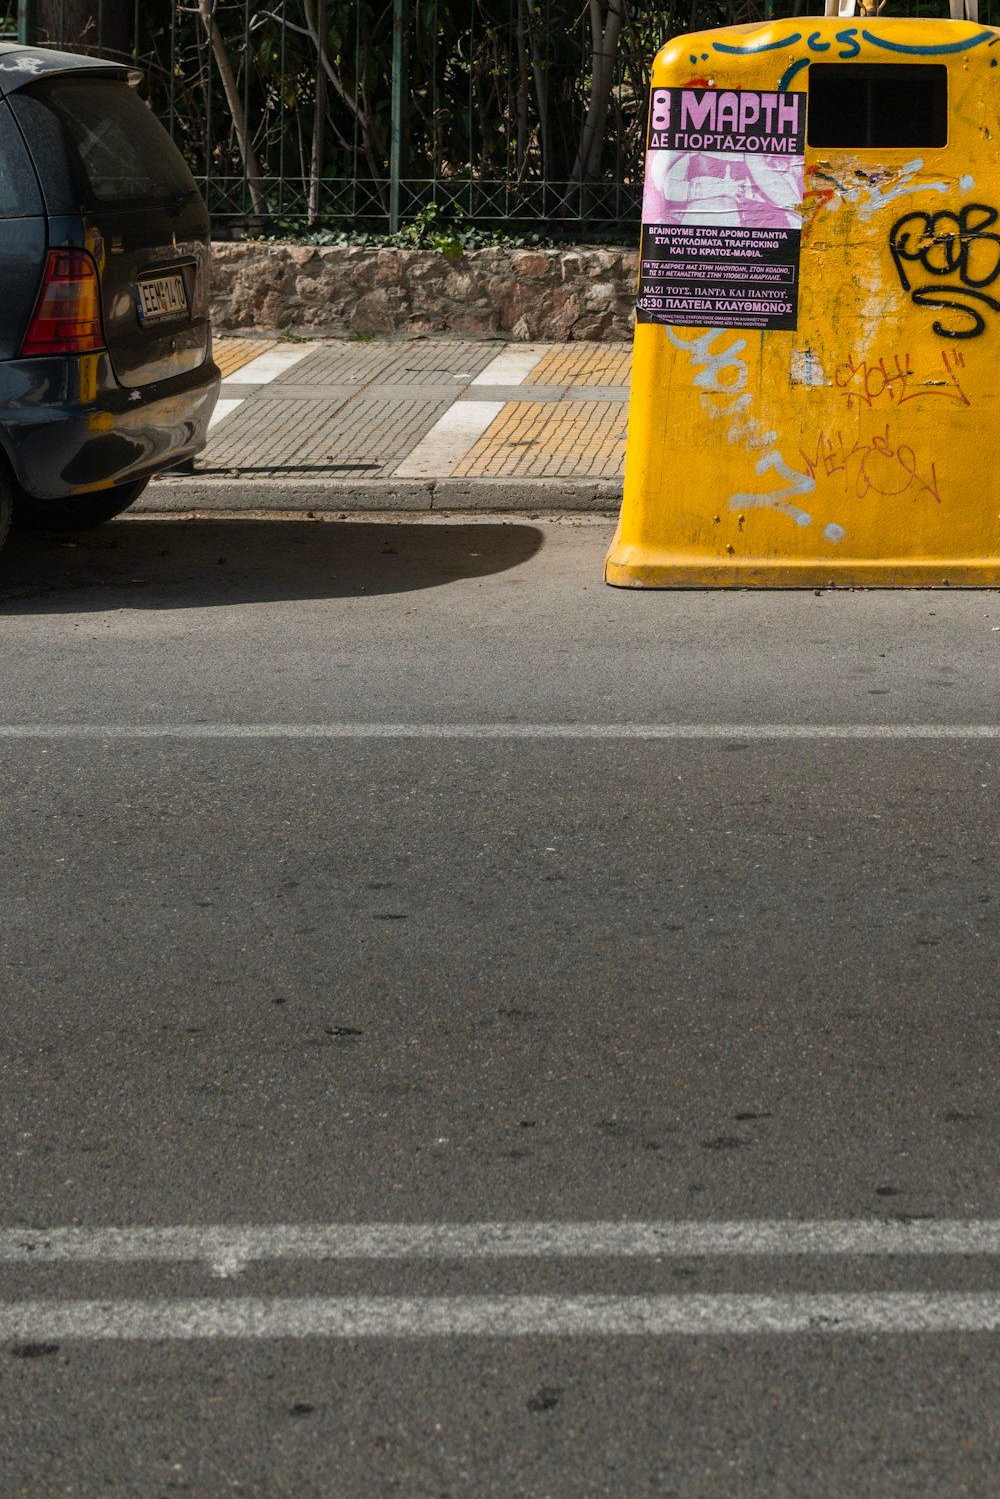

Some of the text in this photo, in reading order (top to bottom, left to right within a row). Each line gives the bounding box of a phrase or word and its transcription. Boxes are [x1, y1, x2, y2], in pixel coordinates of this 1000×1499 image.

[653, 89, 799, 134] 8 ΜΑΡΤΗ
[651, 133, 796, 152] ΔΕ ΓΙΟΡΤΑΖΟΥΜΕ
[649, 227, 788, 240] ΒΓΑΙΝΟΥΜΕ ΣΤΟΝ ΔΡΟΜΟ ΕΝΑΝΤΙΑ
[655, 237, 779, 249] ΣΤΑ ΚΥΚΛΩΜΑΤΑ TRAFFICKING
[670, 247, 685, 255] ΚΑΙ
[700, 248, 763, 258] ΚΡΑΤΟΣ-ΜΑΦΙΑ.
[643, 286, 663, 294] ΜΑΖΙ
[666, 287, 692, 295] ΤΟΥΣ.
[694, 288, 726, 296] ΠΑΝΤΑ
[729, 289, 745, 297] ΚΑΙ
[640, 298, 793, 313] 13:30 ΠΛΑΤΕΙΑ ΚΛΑΥΘΜΩΝΟΣ
